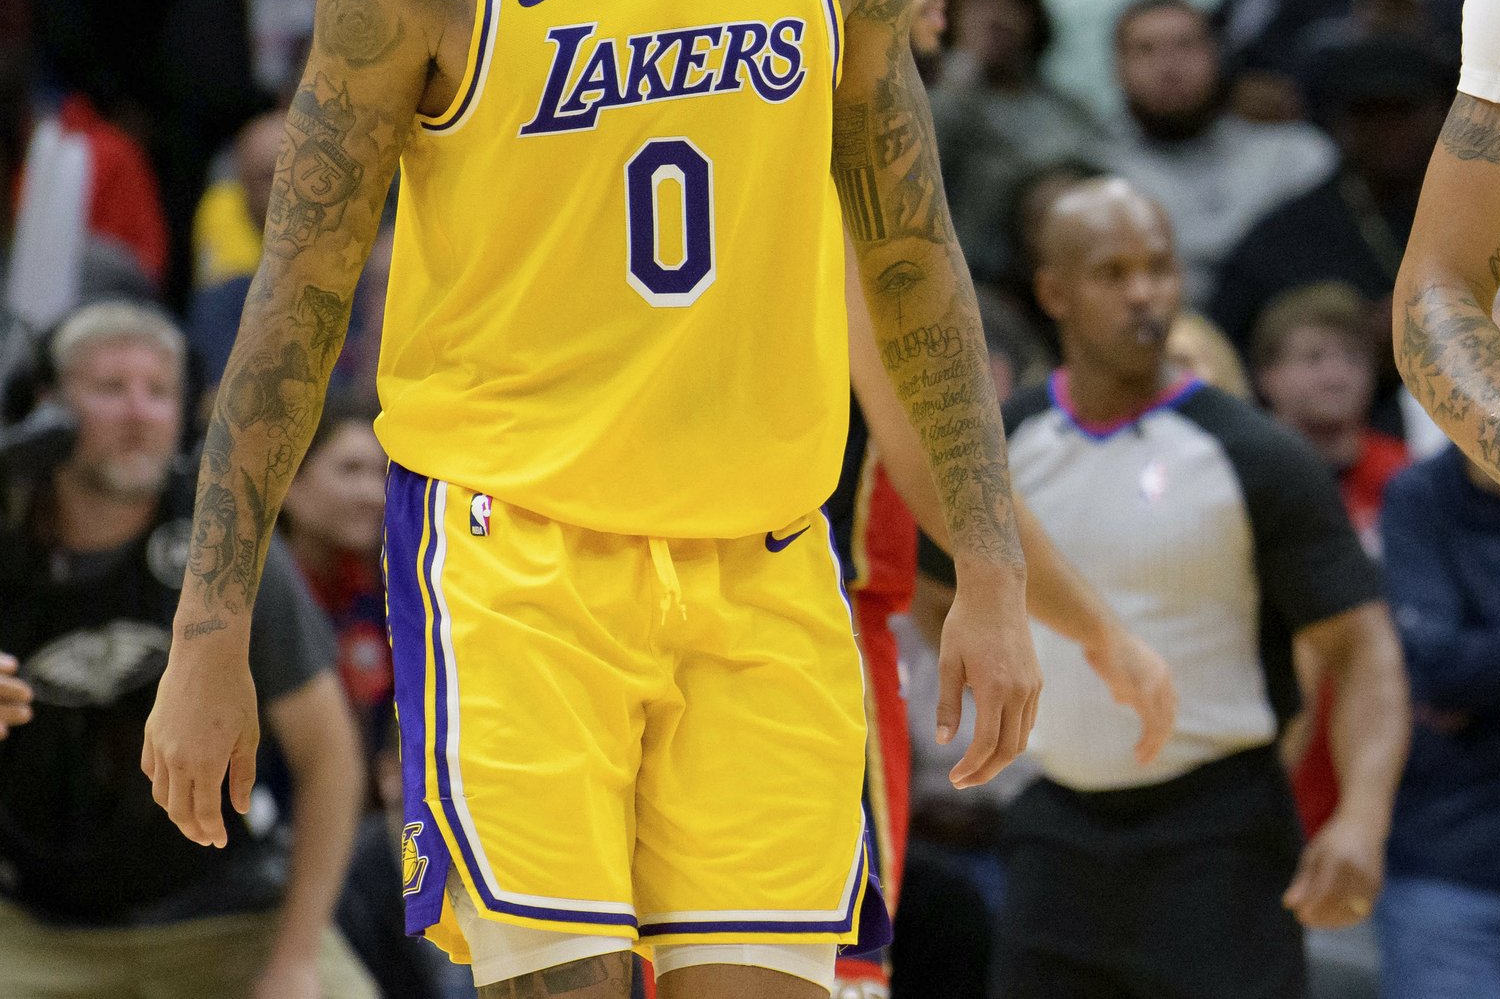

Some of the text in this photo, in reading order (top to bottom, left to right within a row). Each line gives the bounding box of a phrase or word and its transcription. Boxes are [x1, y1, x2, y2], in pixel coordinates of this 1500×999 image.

[516, 17, 807, 138] LAKERS
[301, 152, 341, 195] 75
[624, 136, 717, 308] 0
